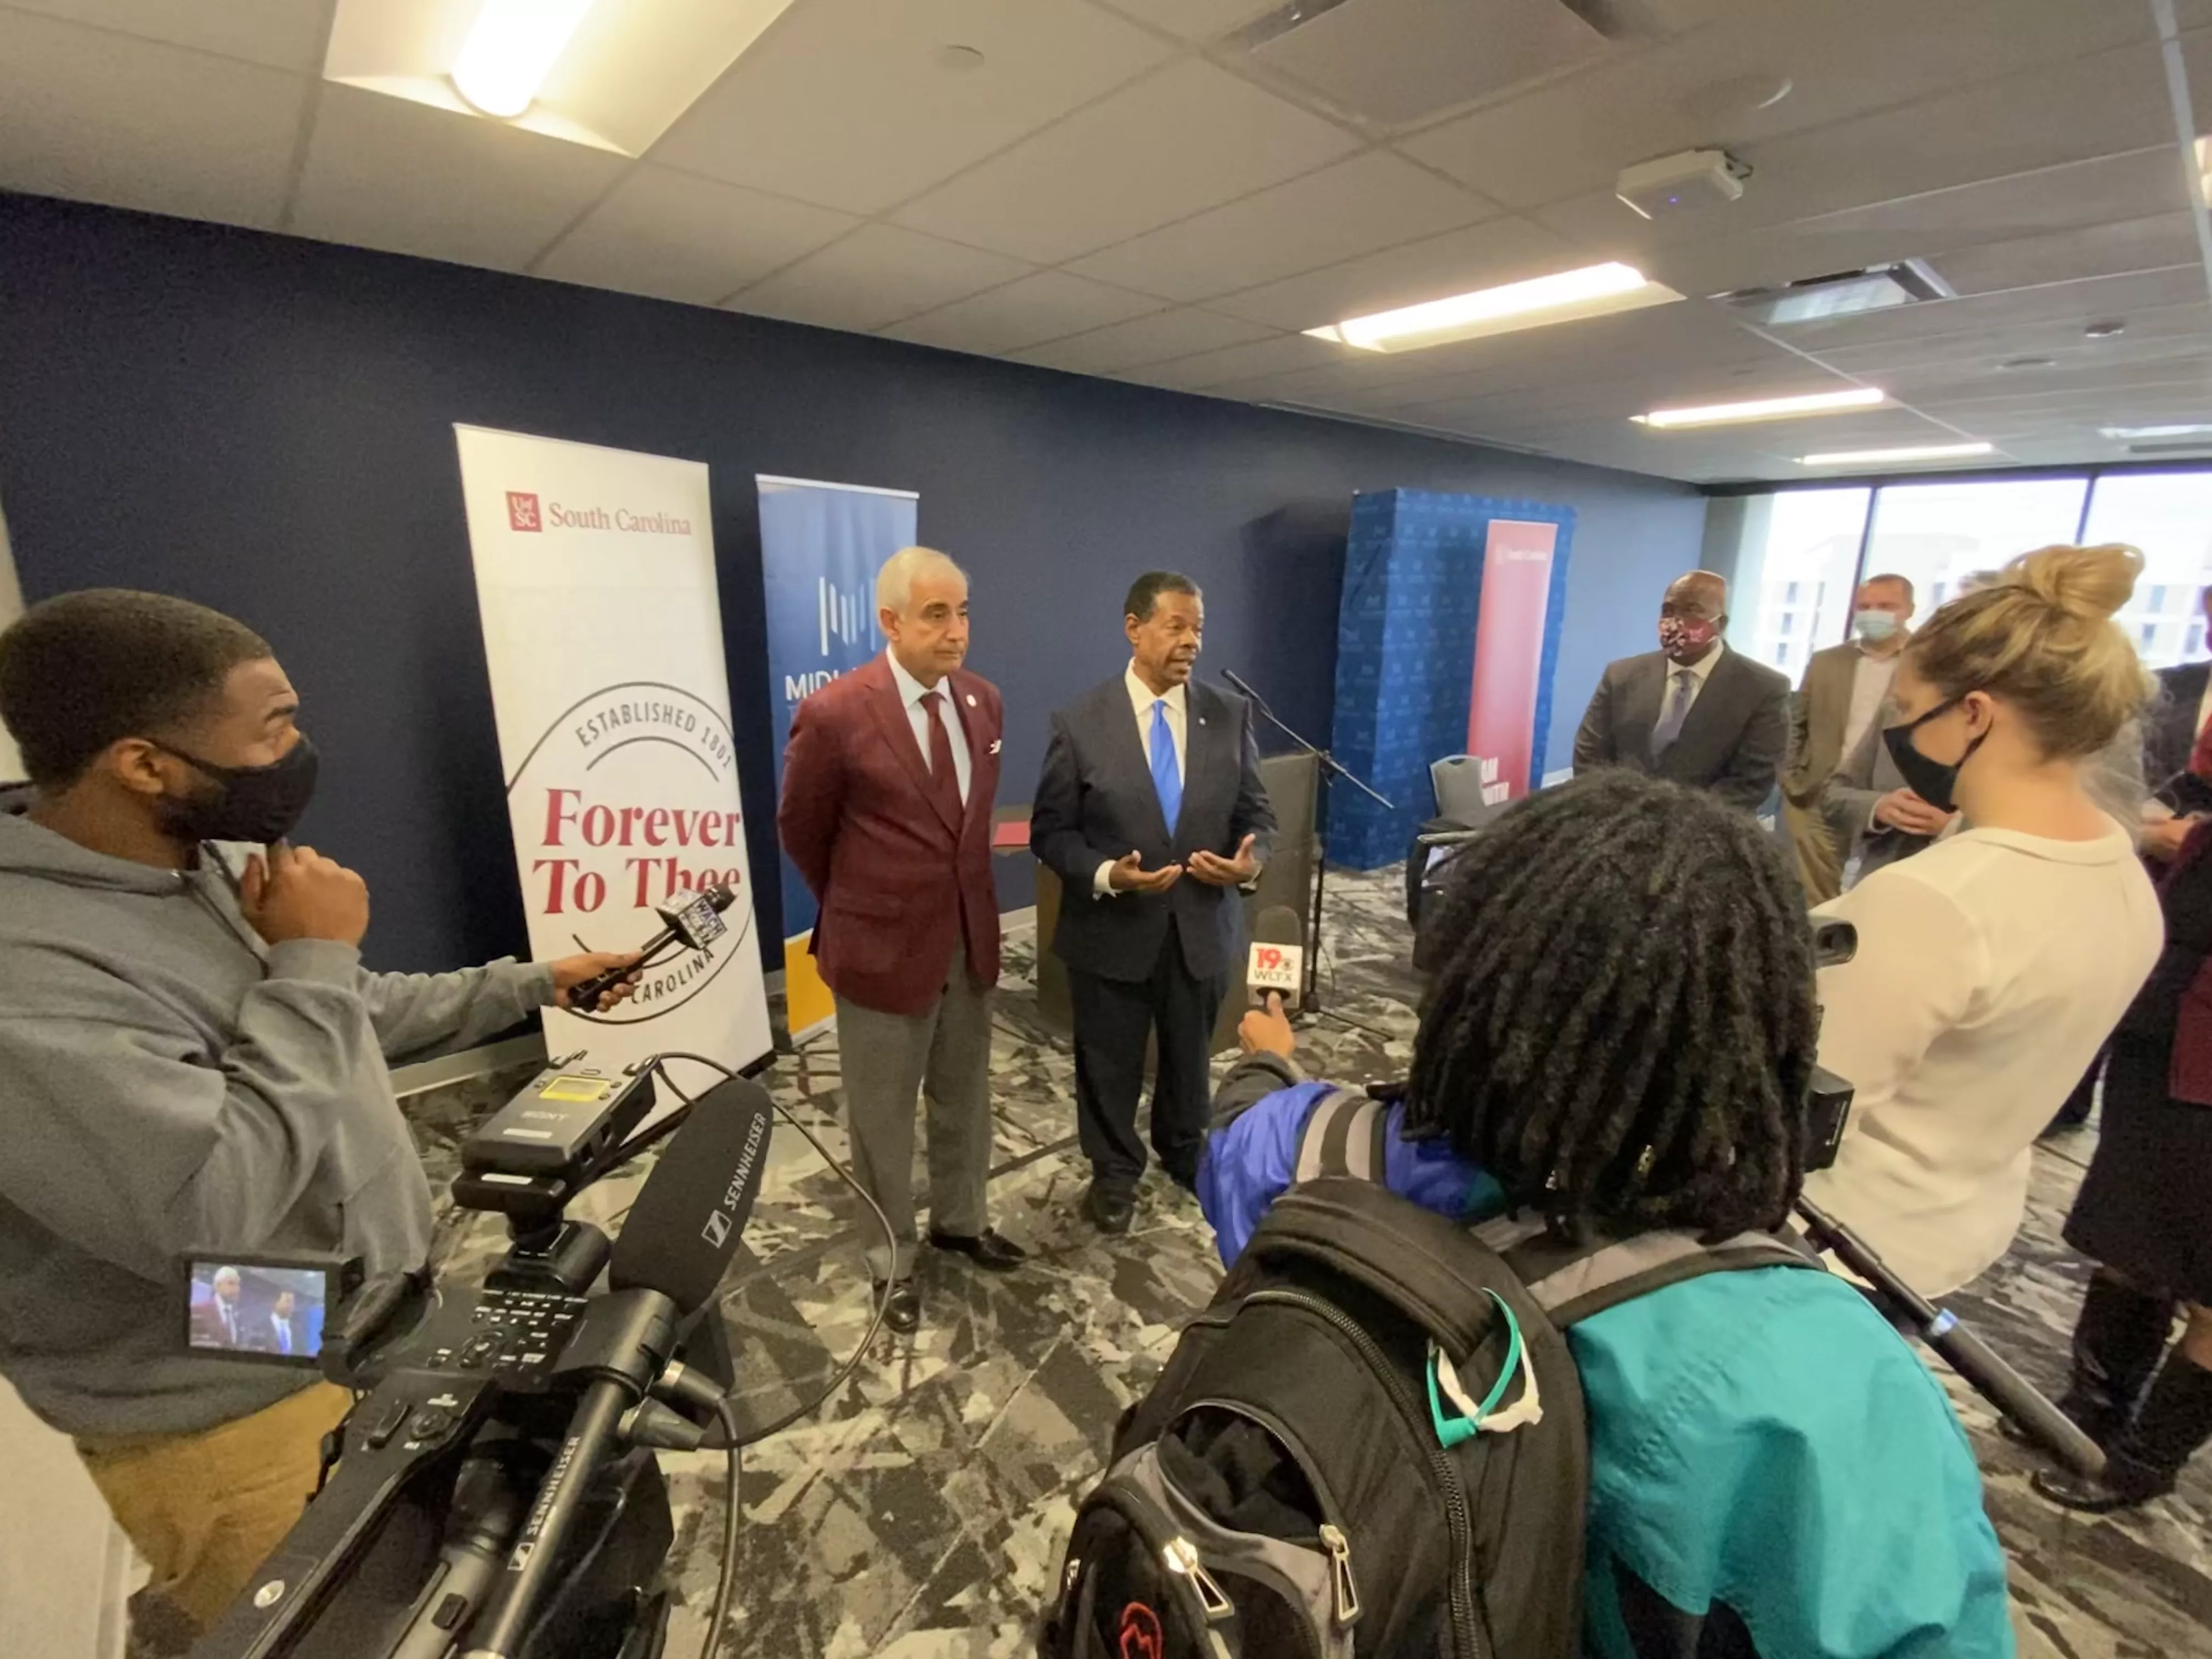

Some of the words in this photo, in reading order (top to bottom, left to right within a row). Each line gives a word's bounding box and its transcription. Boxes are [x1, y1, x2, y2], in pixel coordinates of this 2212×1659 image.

[549, 501, 612, 530] South
[615, 508, 691, 535] Carolina
[575, 701, 697, 748] ESTABLISHED
[701, 726, 732, 770] 1801
[540, 788, 740, 847] Forever
[532, 859, 607, 914] To
[1254, 969, 1293, 982] WLTX
[1256, 948, 1282, 969] 19
[723, 1111, 767, 1211] SENNHEISER
[526, 1436, 581, 1536] SENNHEISER
